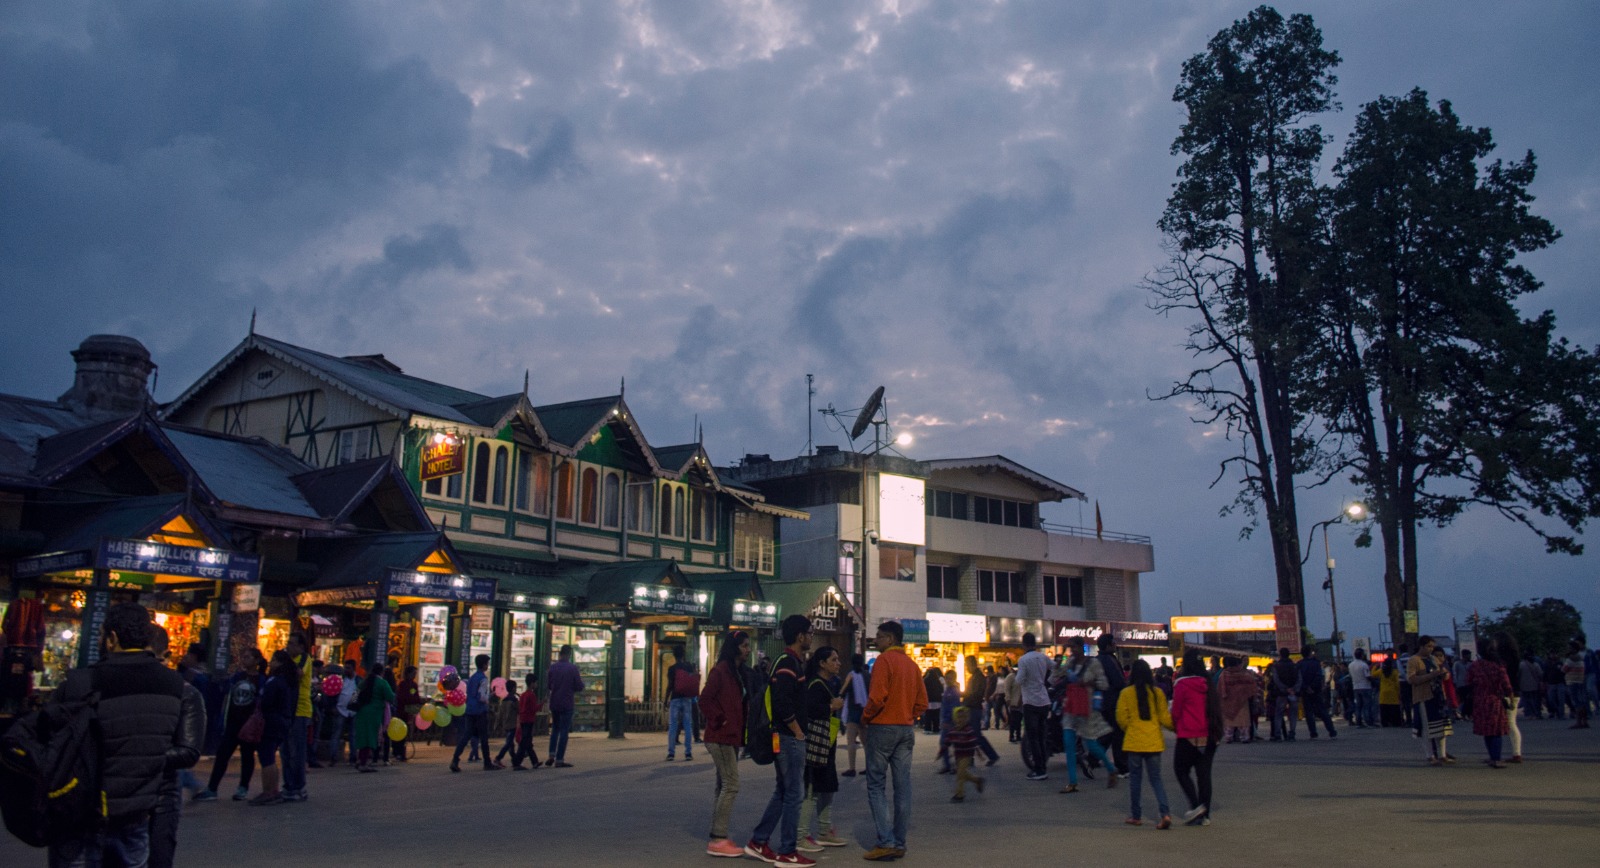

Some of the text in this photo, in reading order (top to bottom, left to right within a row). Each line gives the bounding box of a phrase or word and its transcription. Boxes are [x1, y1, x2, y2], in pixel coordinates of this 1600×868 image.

[423, 442, 460, 462] CHALET
[427, 458, 456, 474] HOTEL
[108, 541, 151, 556] HABEE
[811, 605, 838, 618] HALET
[698, 624, 724, 632] BOOKS
[811, 617, 836, 631] HOTEL
